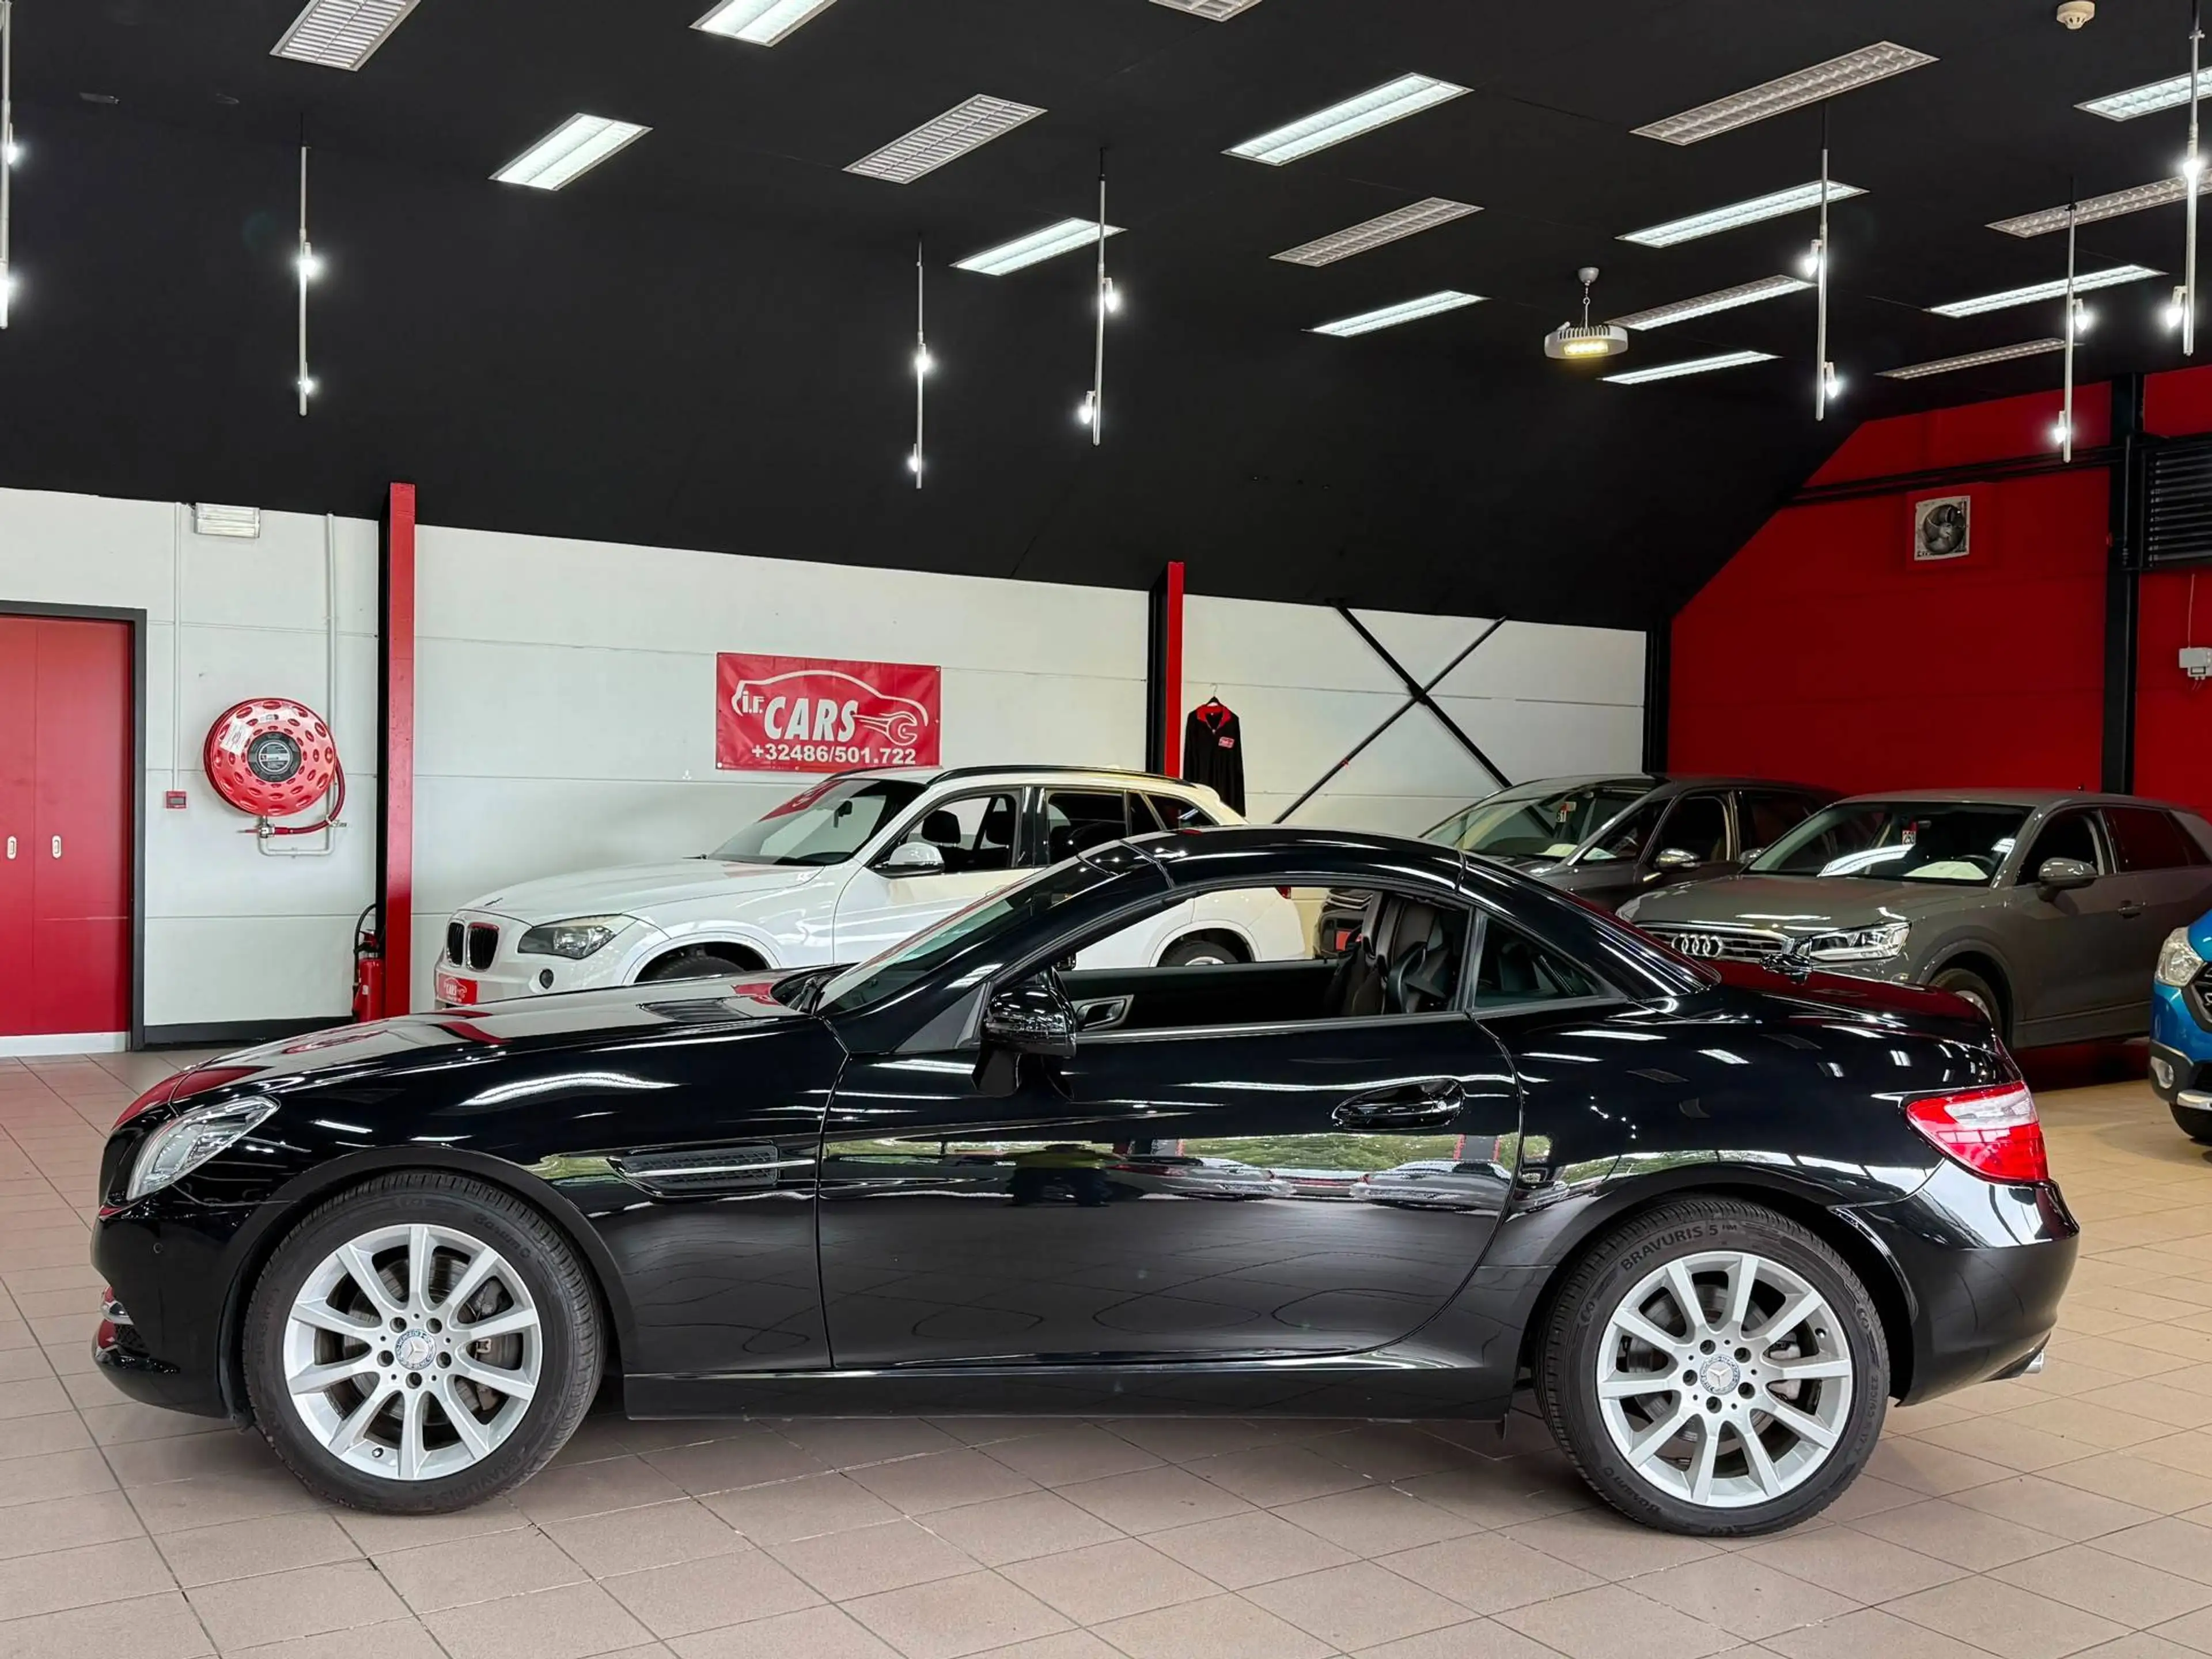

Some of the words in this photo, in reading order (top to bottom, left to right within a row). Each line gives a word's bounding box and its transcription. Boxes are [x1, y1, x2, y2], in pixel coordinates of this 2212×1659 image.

[764, 696, 858, 743] CARS
[752, 744, 916, 765] +32486/501.722
[1620, 1226, 1703, 1271] BRAVURIS
[1709, 1225, 1718, 1236] 5
